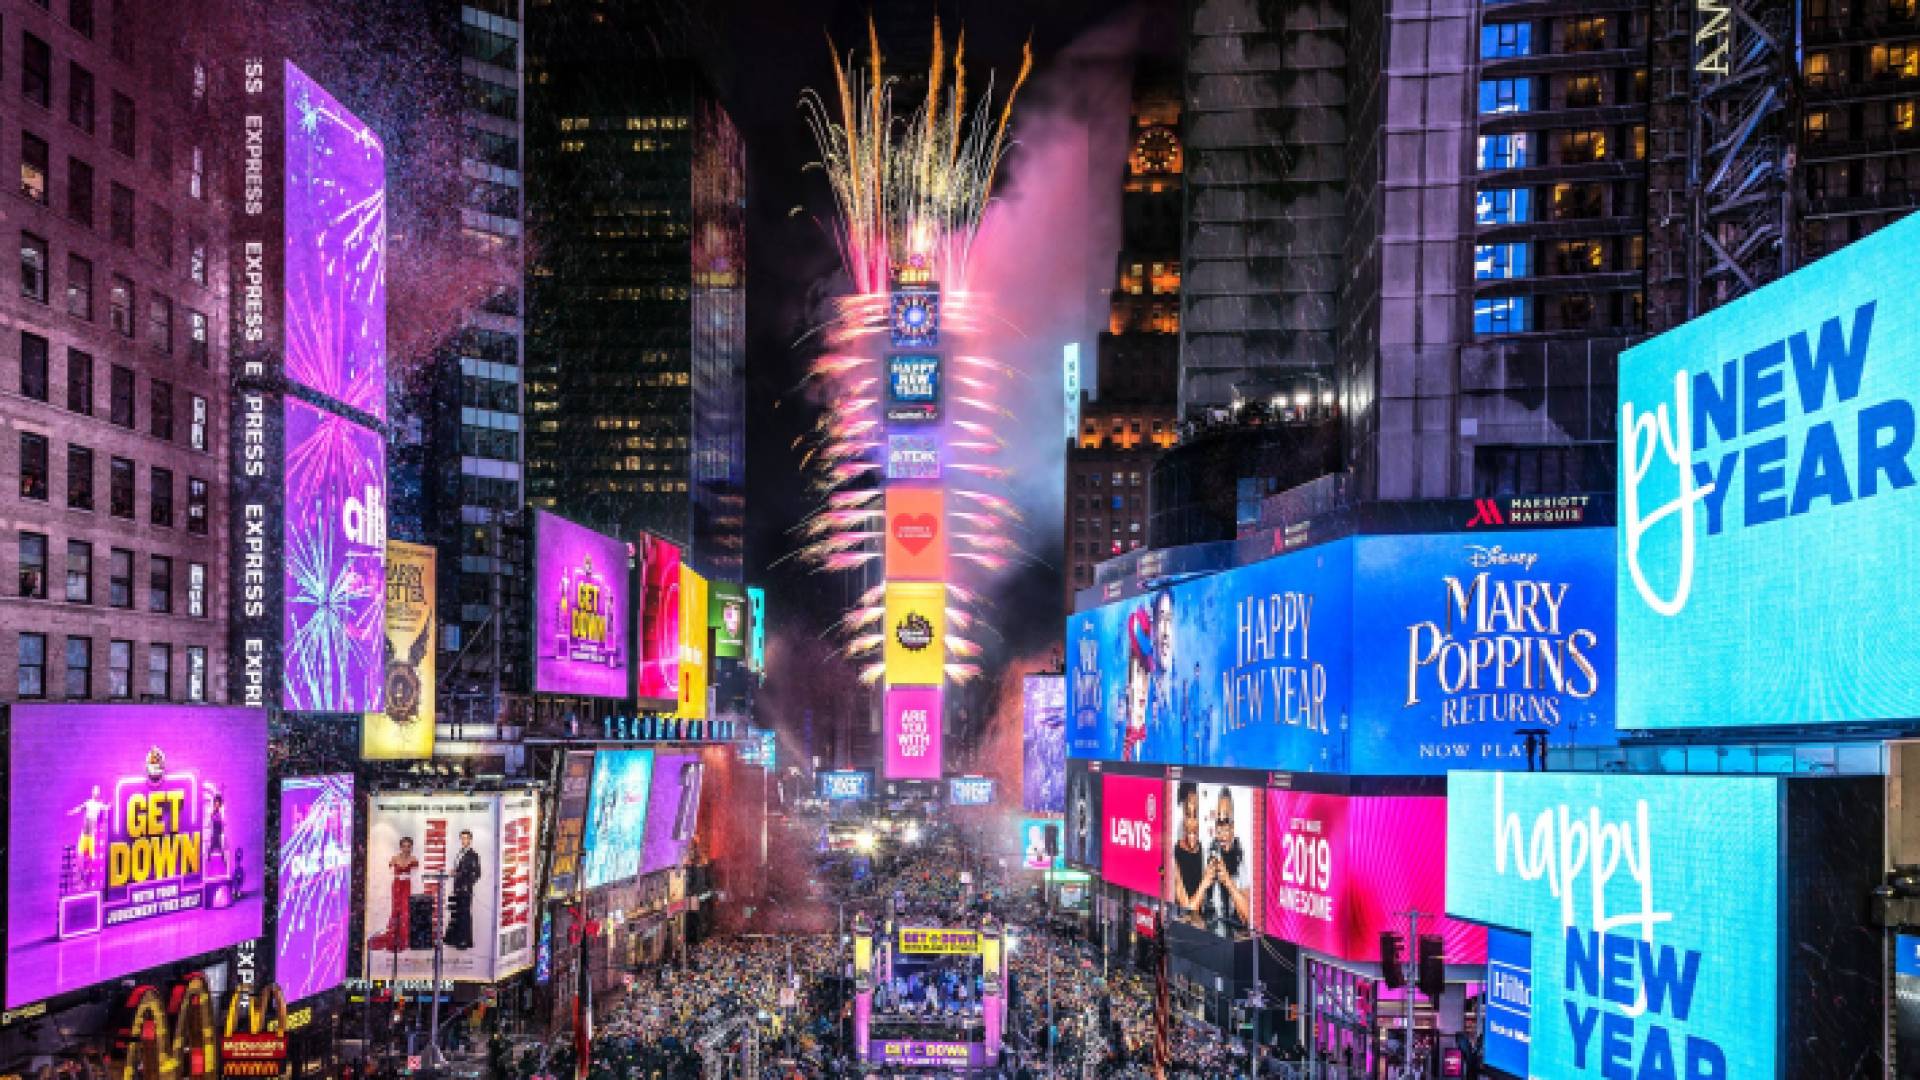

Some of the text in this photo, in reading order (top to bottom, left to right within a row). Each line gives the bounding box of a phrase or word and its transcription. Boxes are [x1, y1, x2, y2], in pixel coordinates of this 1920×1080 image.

[1695, 0, 1730, 75] AM
[246, 57, 263, 93] SS
[245, 115, 263, 215] EXPRESS
[245, 242, 263, 341] EXPRESS
[890, 361, 938, 374] HAPPY
[1692, 300, 1878, 452] NEW
[1692, 398, 1918, 537] YEAR
[1511, 495, 1589, 509] MARRIOTT
[1511, 511, 1581, 522] MARQUIS
[245, 504, 263, 617] EXPRESS
[1236, 591, 1315, 669] HAPPY
[1442, 571, 1570, 634] MARY
[1403, 620, 1599, 708] POPPINS
[902, 709, 927, 722] ARE
[902, 722, 927, 734] YOU
[1222, 663, 1330, 736] NEW YEAR
[1441, 693, 1562, 728] RETURNS
[897, 734, 931, 746] WITH
[1419, 743, 1471, 758] NOW
[126, 790, 186, 838] GET
[109, 831, 202, 888] DOWN
[1282, 833, 1333, 892] 2019
[1494, 772, 1673, 1016] happy
[1565, 925, 1702, 1021] NEW
[1564, 1000, 1728, 1080] YEAR
